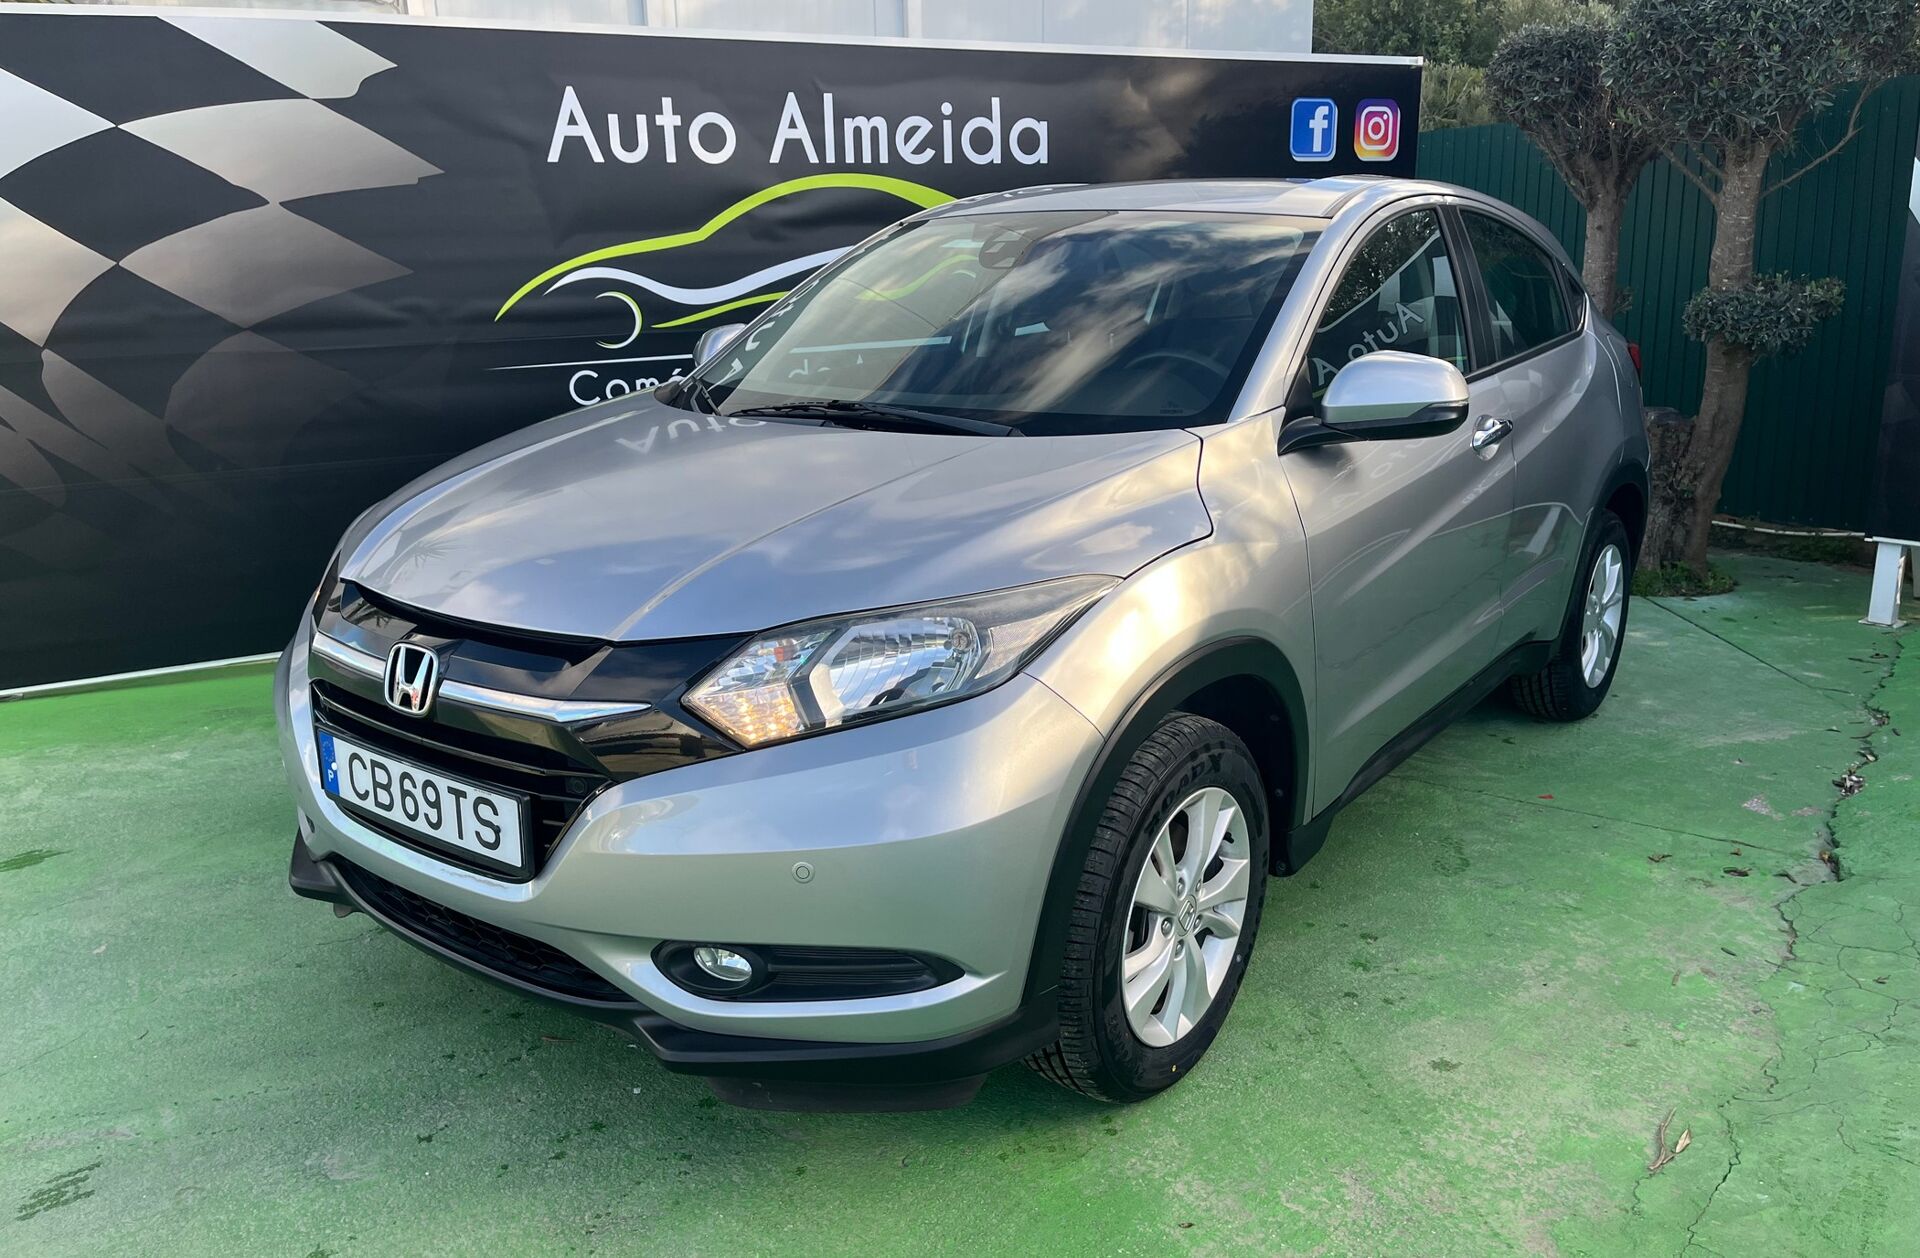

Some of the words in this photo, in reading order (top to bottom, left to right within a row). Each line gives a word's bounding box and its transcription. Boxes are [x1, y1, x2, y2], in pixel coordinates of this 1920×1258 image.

[547, 85, 737, 164] Auto
[769, 91, 1050, 164] Almeida
[327, 769, 335, 783] P
[349, 752, 501, 851] CB69TS
